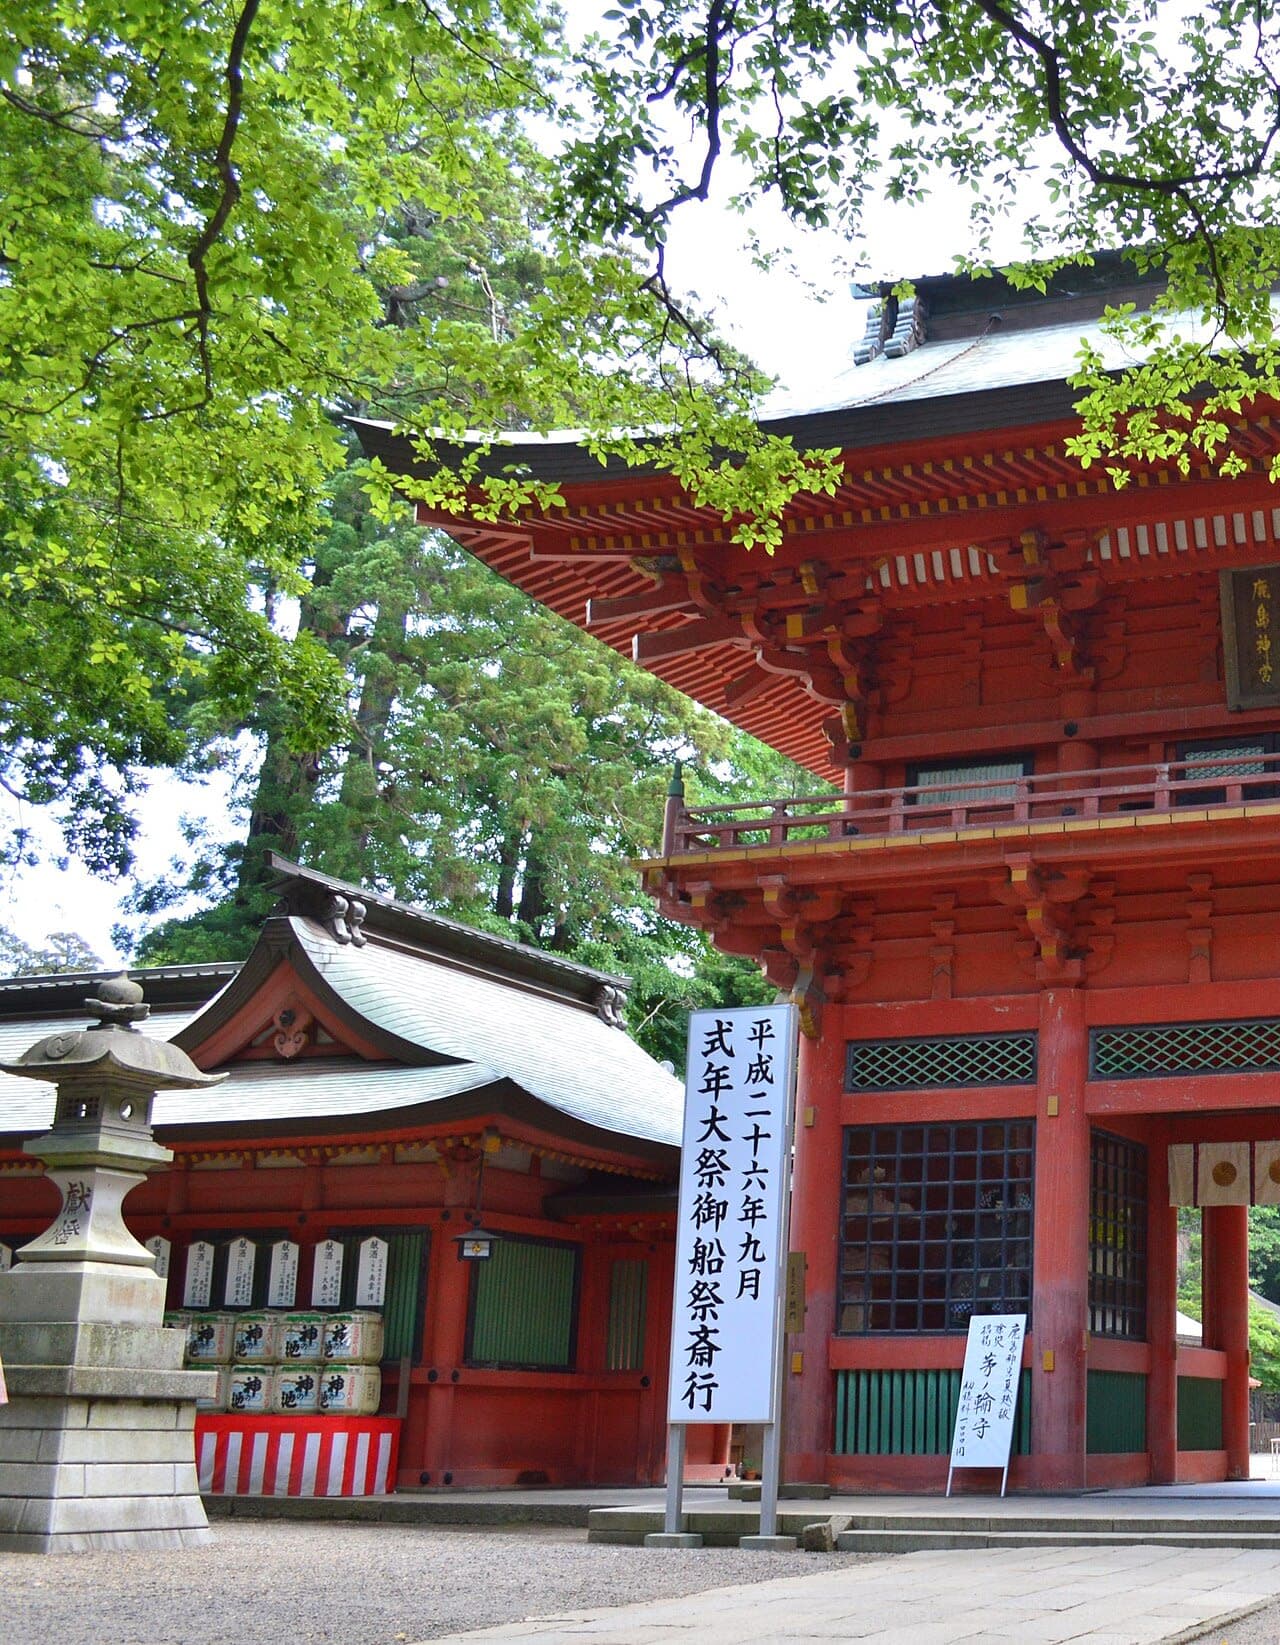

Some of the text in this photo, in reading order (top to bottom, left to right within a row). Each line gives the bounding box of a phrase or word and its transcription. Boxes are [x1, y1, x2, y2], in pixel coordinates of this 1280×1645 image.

[1252, 578, 1272, 683] 鹿島神宮
[681, 1019, 736, 1413] 式年大祭御船祭斎行
[734, 1018, 776, 1302] 平成二十六年九月
